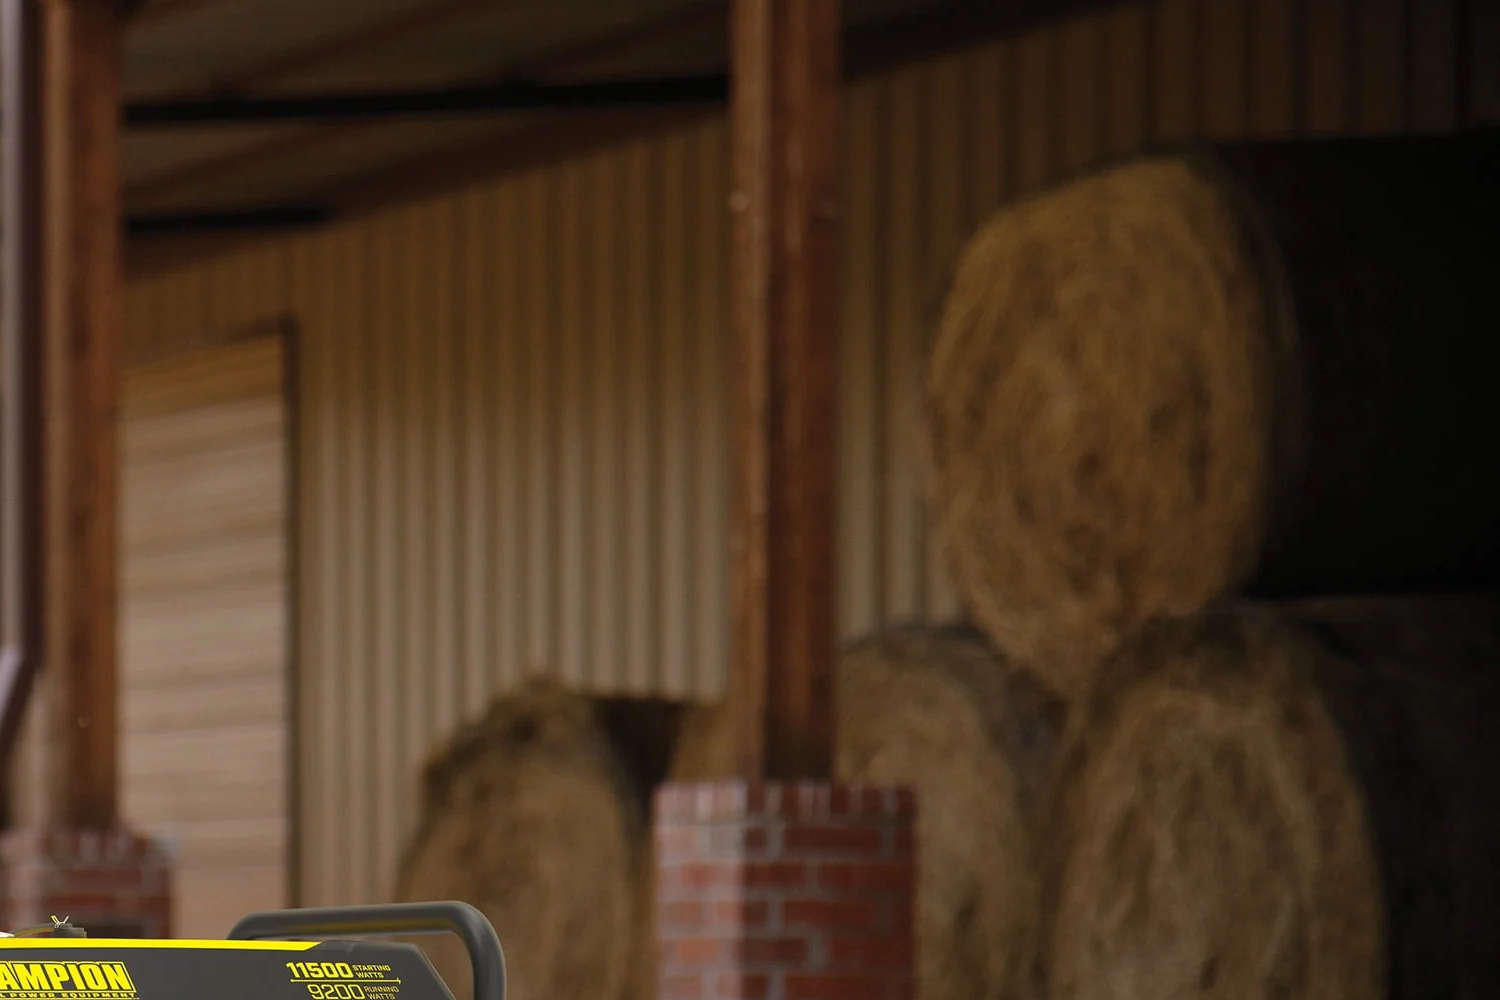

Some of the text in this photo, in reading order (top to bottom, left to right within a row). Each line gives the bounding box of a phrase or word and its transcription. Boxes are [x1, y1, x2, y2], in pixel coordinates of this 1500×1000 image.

[286, 962, 354, 979] 11500
[352, 964, 391, 972] STARTING
[307, 984, 366, 1000] 9200
